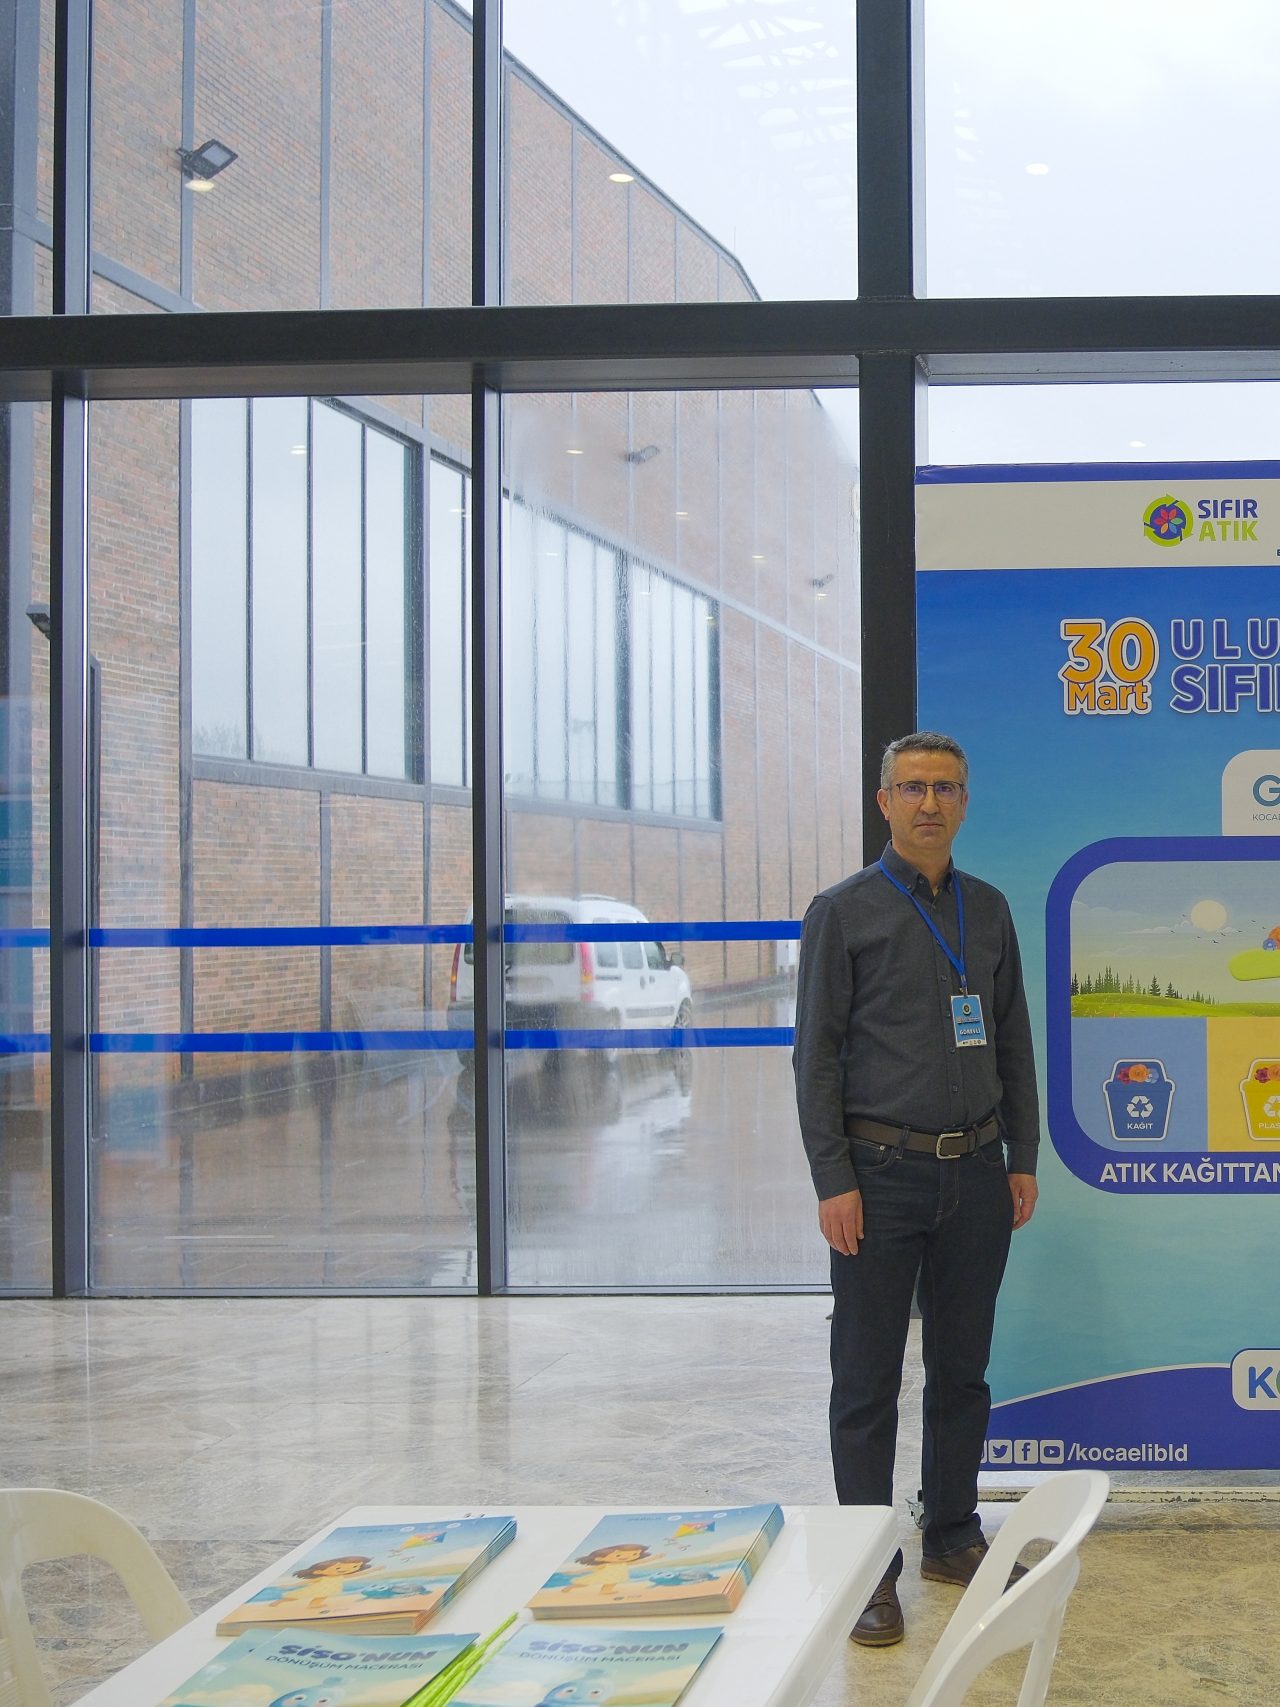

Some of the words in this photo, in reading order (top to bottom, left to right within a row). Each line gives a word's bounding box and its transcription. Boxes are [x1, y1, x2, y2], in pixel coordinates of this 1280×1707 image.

[1197, 499, 1258, 519] SIFIR
[1198, 520, 1259, 542] ATIK
[1058, 617, 1159, 684] 30
[1064, 680, 1152, 714] Mart
[1126, 1120, 1154, 1130] KAĞIT
[1100, 1162, 1157, 1183] ATIK
[1067, 1443, 1188, 1462] /kocaelibld
[265, 1655, 343, 1670] DÖNÜŞÜM
[344, 1662, 425, 1671] MACERASI
[600, 1655, 681, 1663] MACERASI
